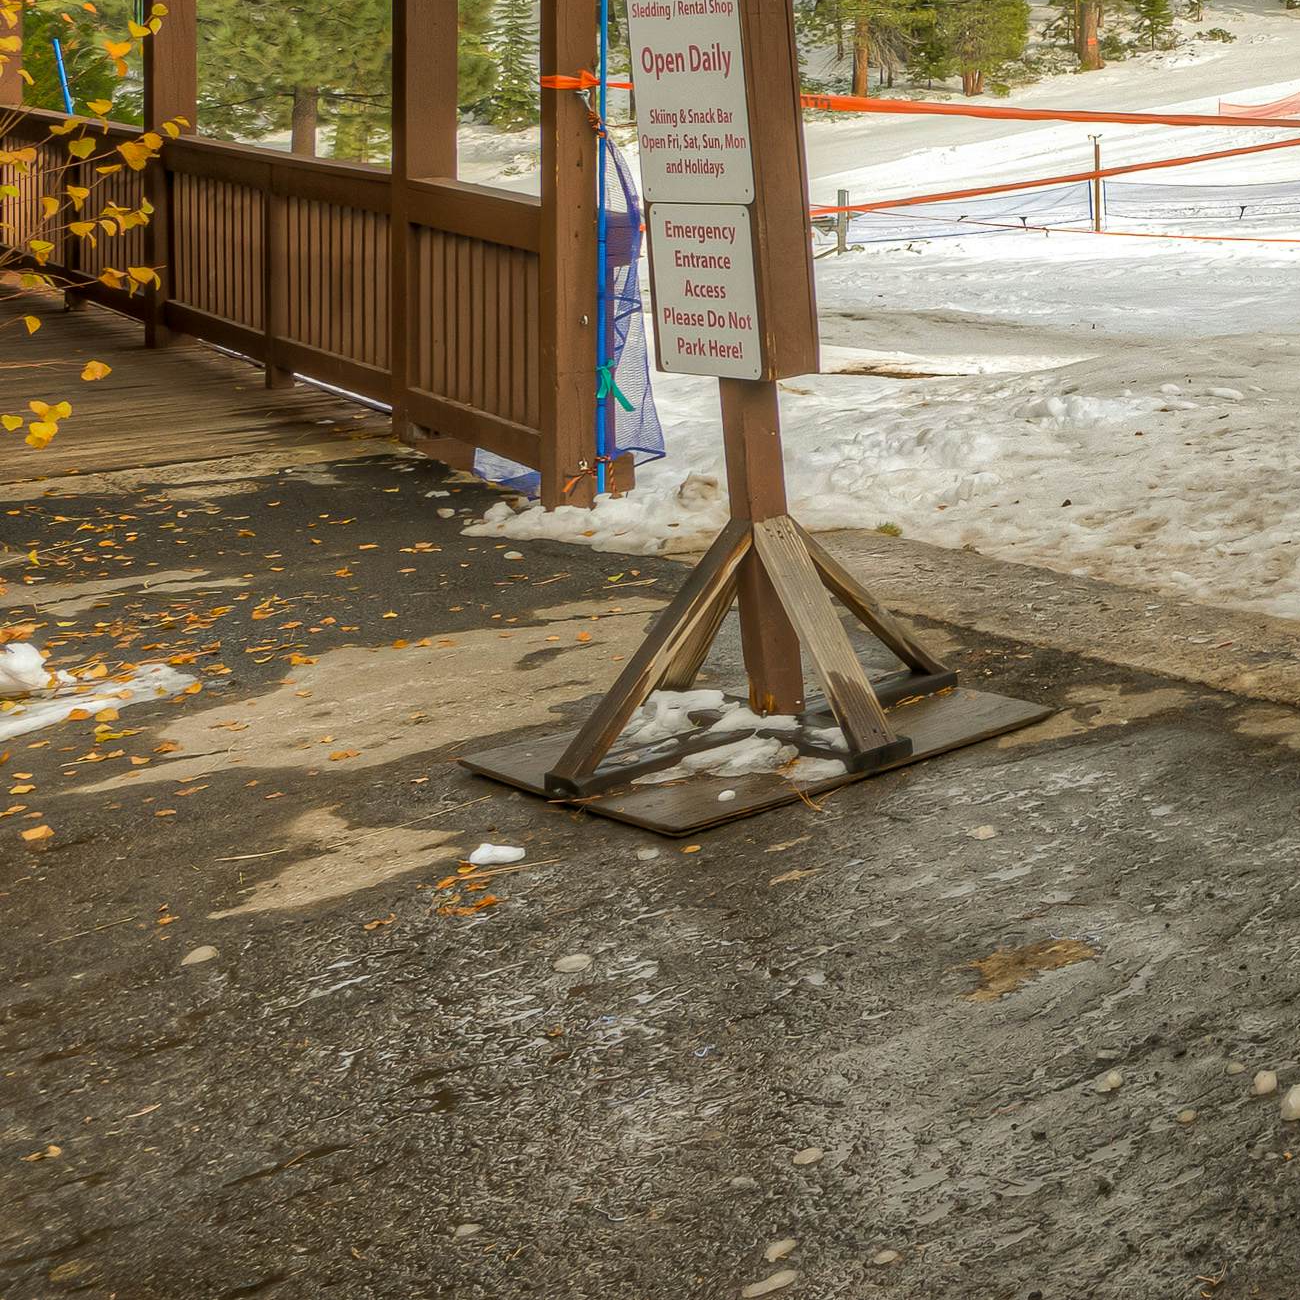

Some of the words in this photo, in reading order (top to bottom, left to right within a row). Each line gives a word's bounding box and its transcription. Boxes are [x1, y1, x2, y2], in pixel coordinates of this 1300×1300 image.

[632, 1, 671, 20] Sledding
[678, 0, 707, 16] Rental
[641, 46, 685, 80] Open
[689, 43, 732, 79] Daily
[650, 109, 678, 128] Skiing
[679, 110, 687, 124] &
[688, 108, 715, 124] Snack
[717, 108, 733, 124] Bar
[641, 135, 666, 152] Open
[667, 134, 682, 151] Fri,
[683, 134, 701, 150] Sat,
[703, 135, 723, 150] Sun,
[725, 135, 746, 149] Mon
[666, 159, 683, 174] and
[684, 159, 725, 178] Holidays
[664, 220, 736, 244] Emergency
[675, 250, 731, 269] Entrance
[684, 280, 726, 299] Access
[663, 307, 704, 327] Please
[708, 310, 726, 328] Do
[729, 311, 752, 330] Not
[677, 337, 707, 357] Park
[709, 340, 744, 360] Here!
